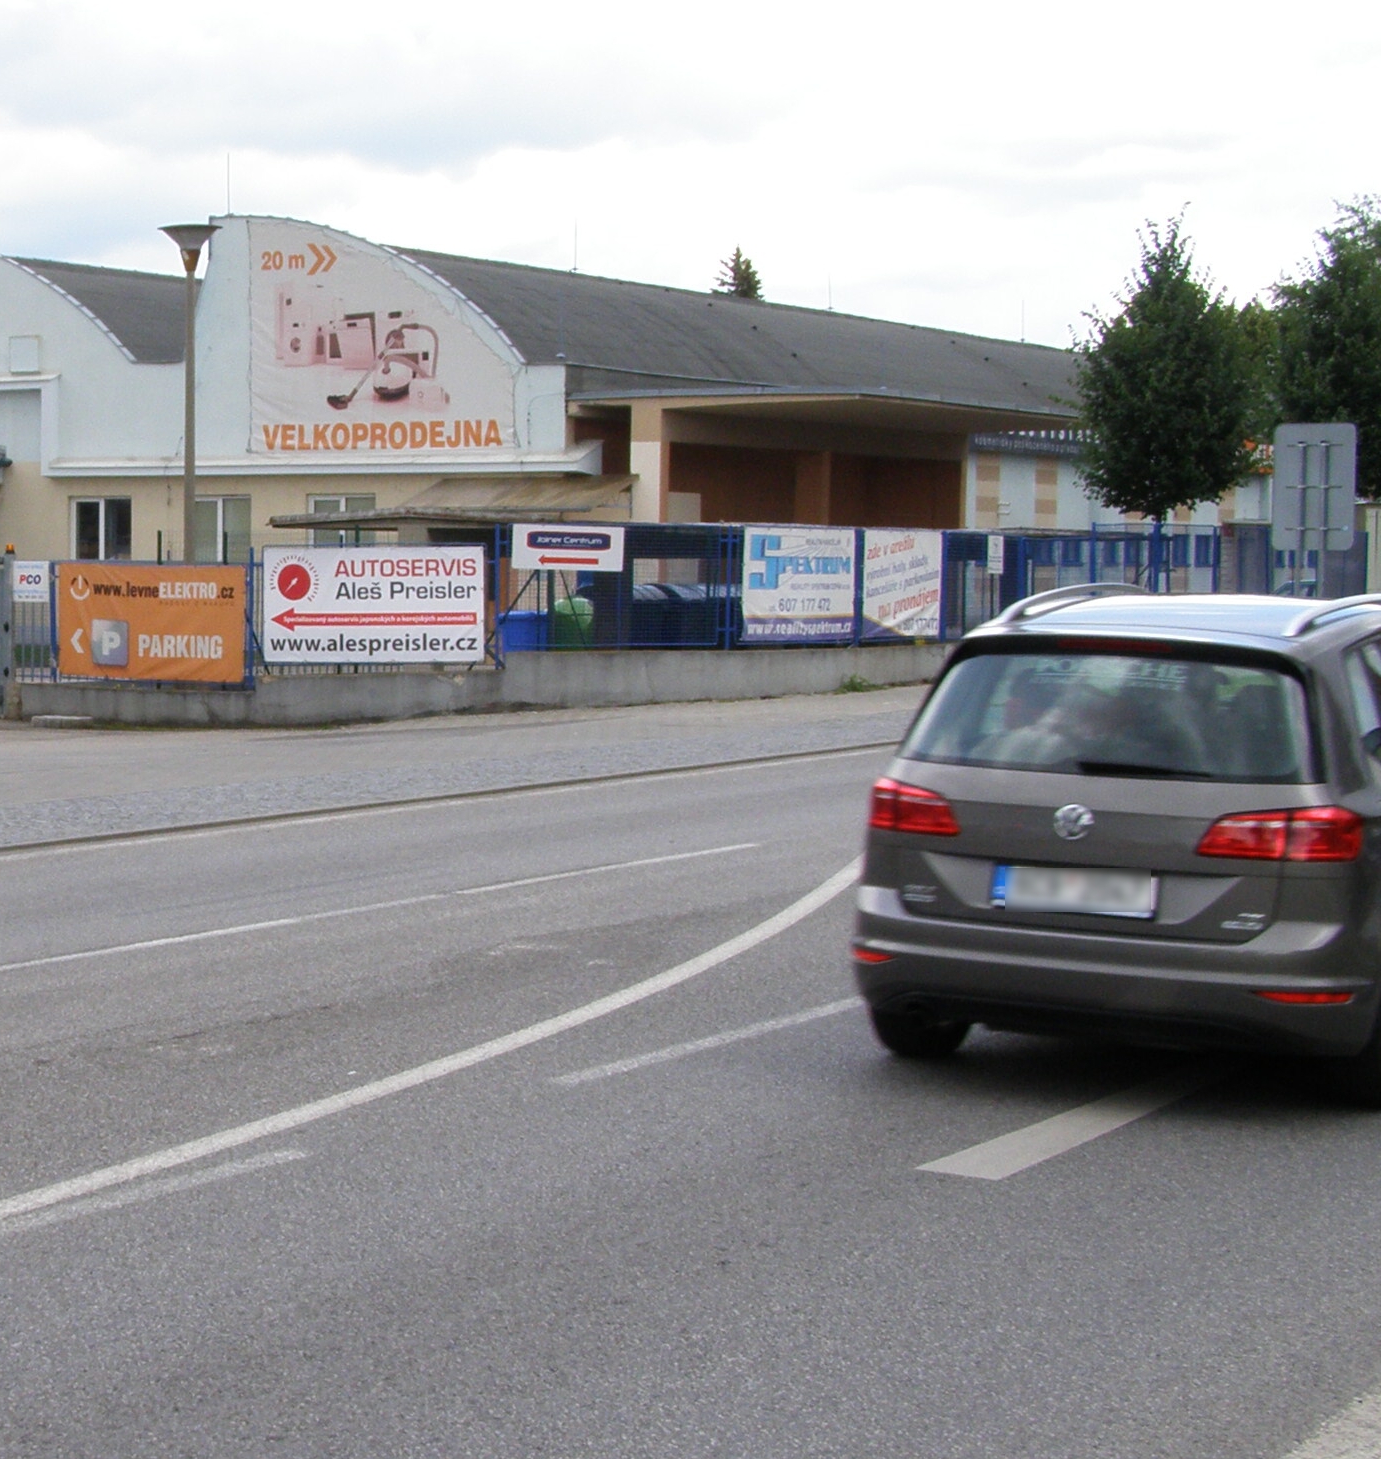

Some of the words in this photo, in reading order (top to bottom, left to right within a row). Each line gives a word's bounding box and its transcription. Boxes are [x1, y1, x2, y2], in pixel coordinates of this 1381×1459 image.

[260, 250, 284, 271] 20
[288, 253, 306, 269] m
[262, 419, 503, 451] VELKOPRODEJNA
[563, 536, 603, 545] Centrum
[334, 558, 477, 578] AUTOSERVIS
[748, 533, 851, 590] SPEKTRUM
[19, 573, 42, 585] PCO
[93, 581, 235, 600] www.levneELEKTRO.cz
[335, 581, 382, 600] Aleš
[390, 581, 477, 600] Preisler
[779, 598, 797, 612] 607
[801, 598, 816, 611] 177
[818, 598, 831, 611] 472
[893, 588, 939, 620] pronájem
[747, 621, 852, 635] www.realityspektrum.cz
[102, 631, 121, 656] P
[137, 634, 223, 660] PARKING
[270, 633, 478, 656] www.alespreisler.cz
